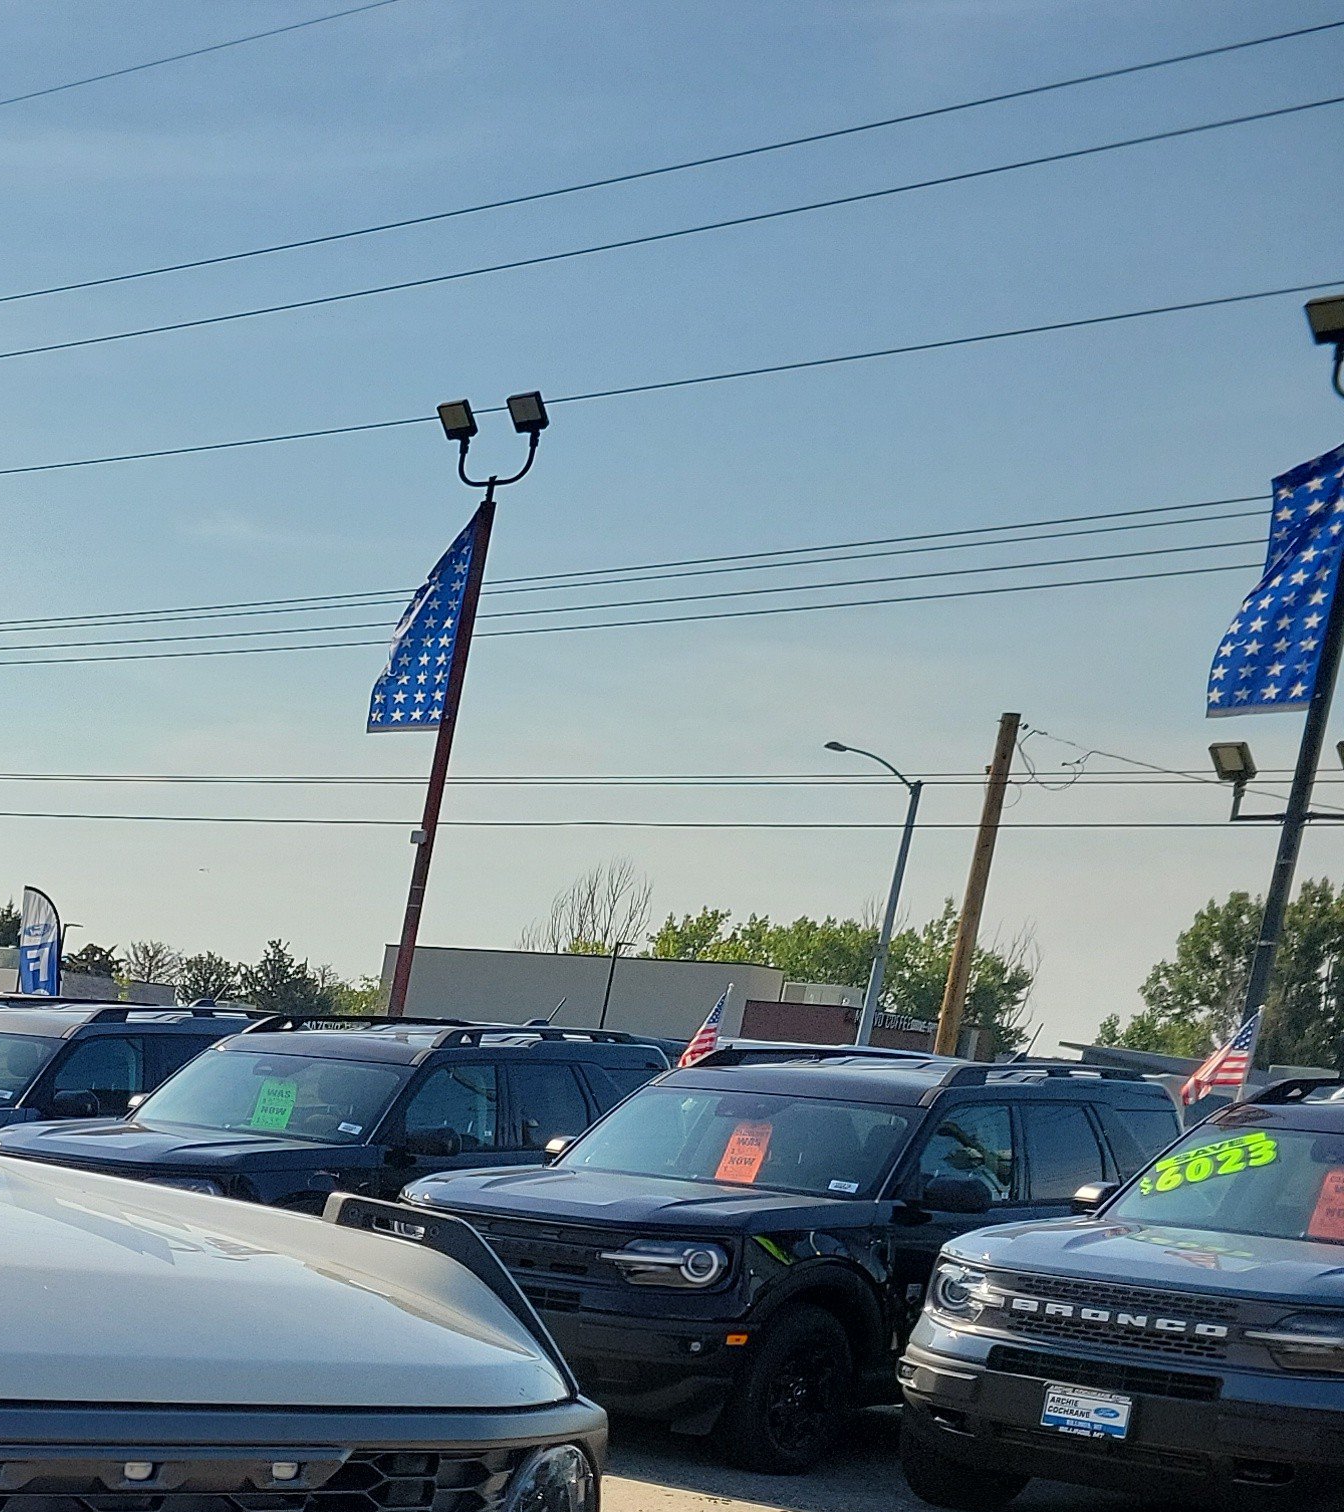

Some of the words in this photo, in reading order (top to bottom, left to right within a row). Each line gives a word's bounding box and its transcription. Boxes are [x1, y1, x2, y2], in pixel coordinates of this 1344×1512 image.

[267, 1088, 291, 1098] WAS
[260, 1105, 287, 1116] NOW
[1172, 1137, 1246, 1164] SAVE
[1139, 1140, 1278, 1196] $6023
[1012, 1298, 1229, 1338] BRONCO
[1049, 1396, 1079, 1407] ARCHIE
[1047, 1406, 1090, 1419] COCHRANE
